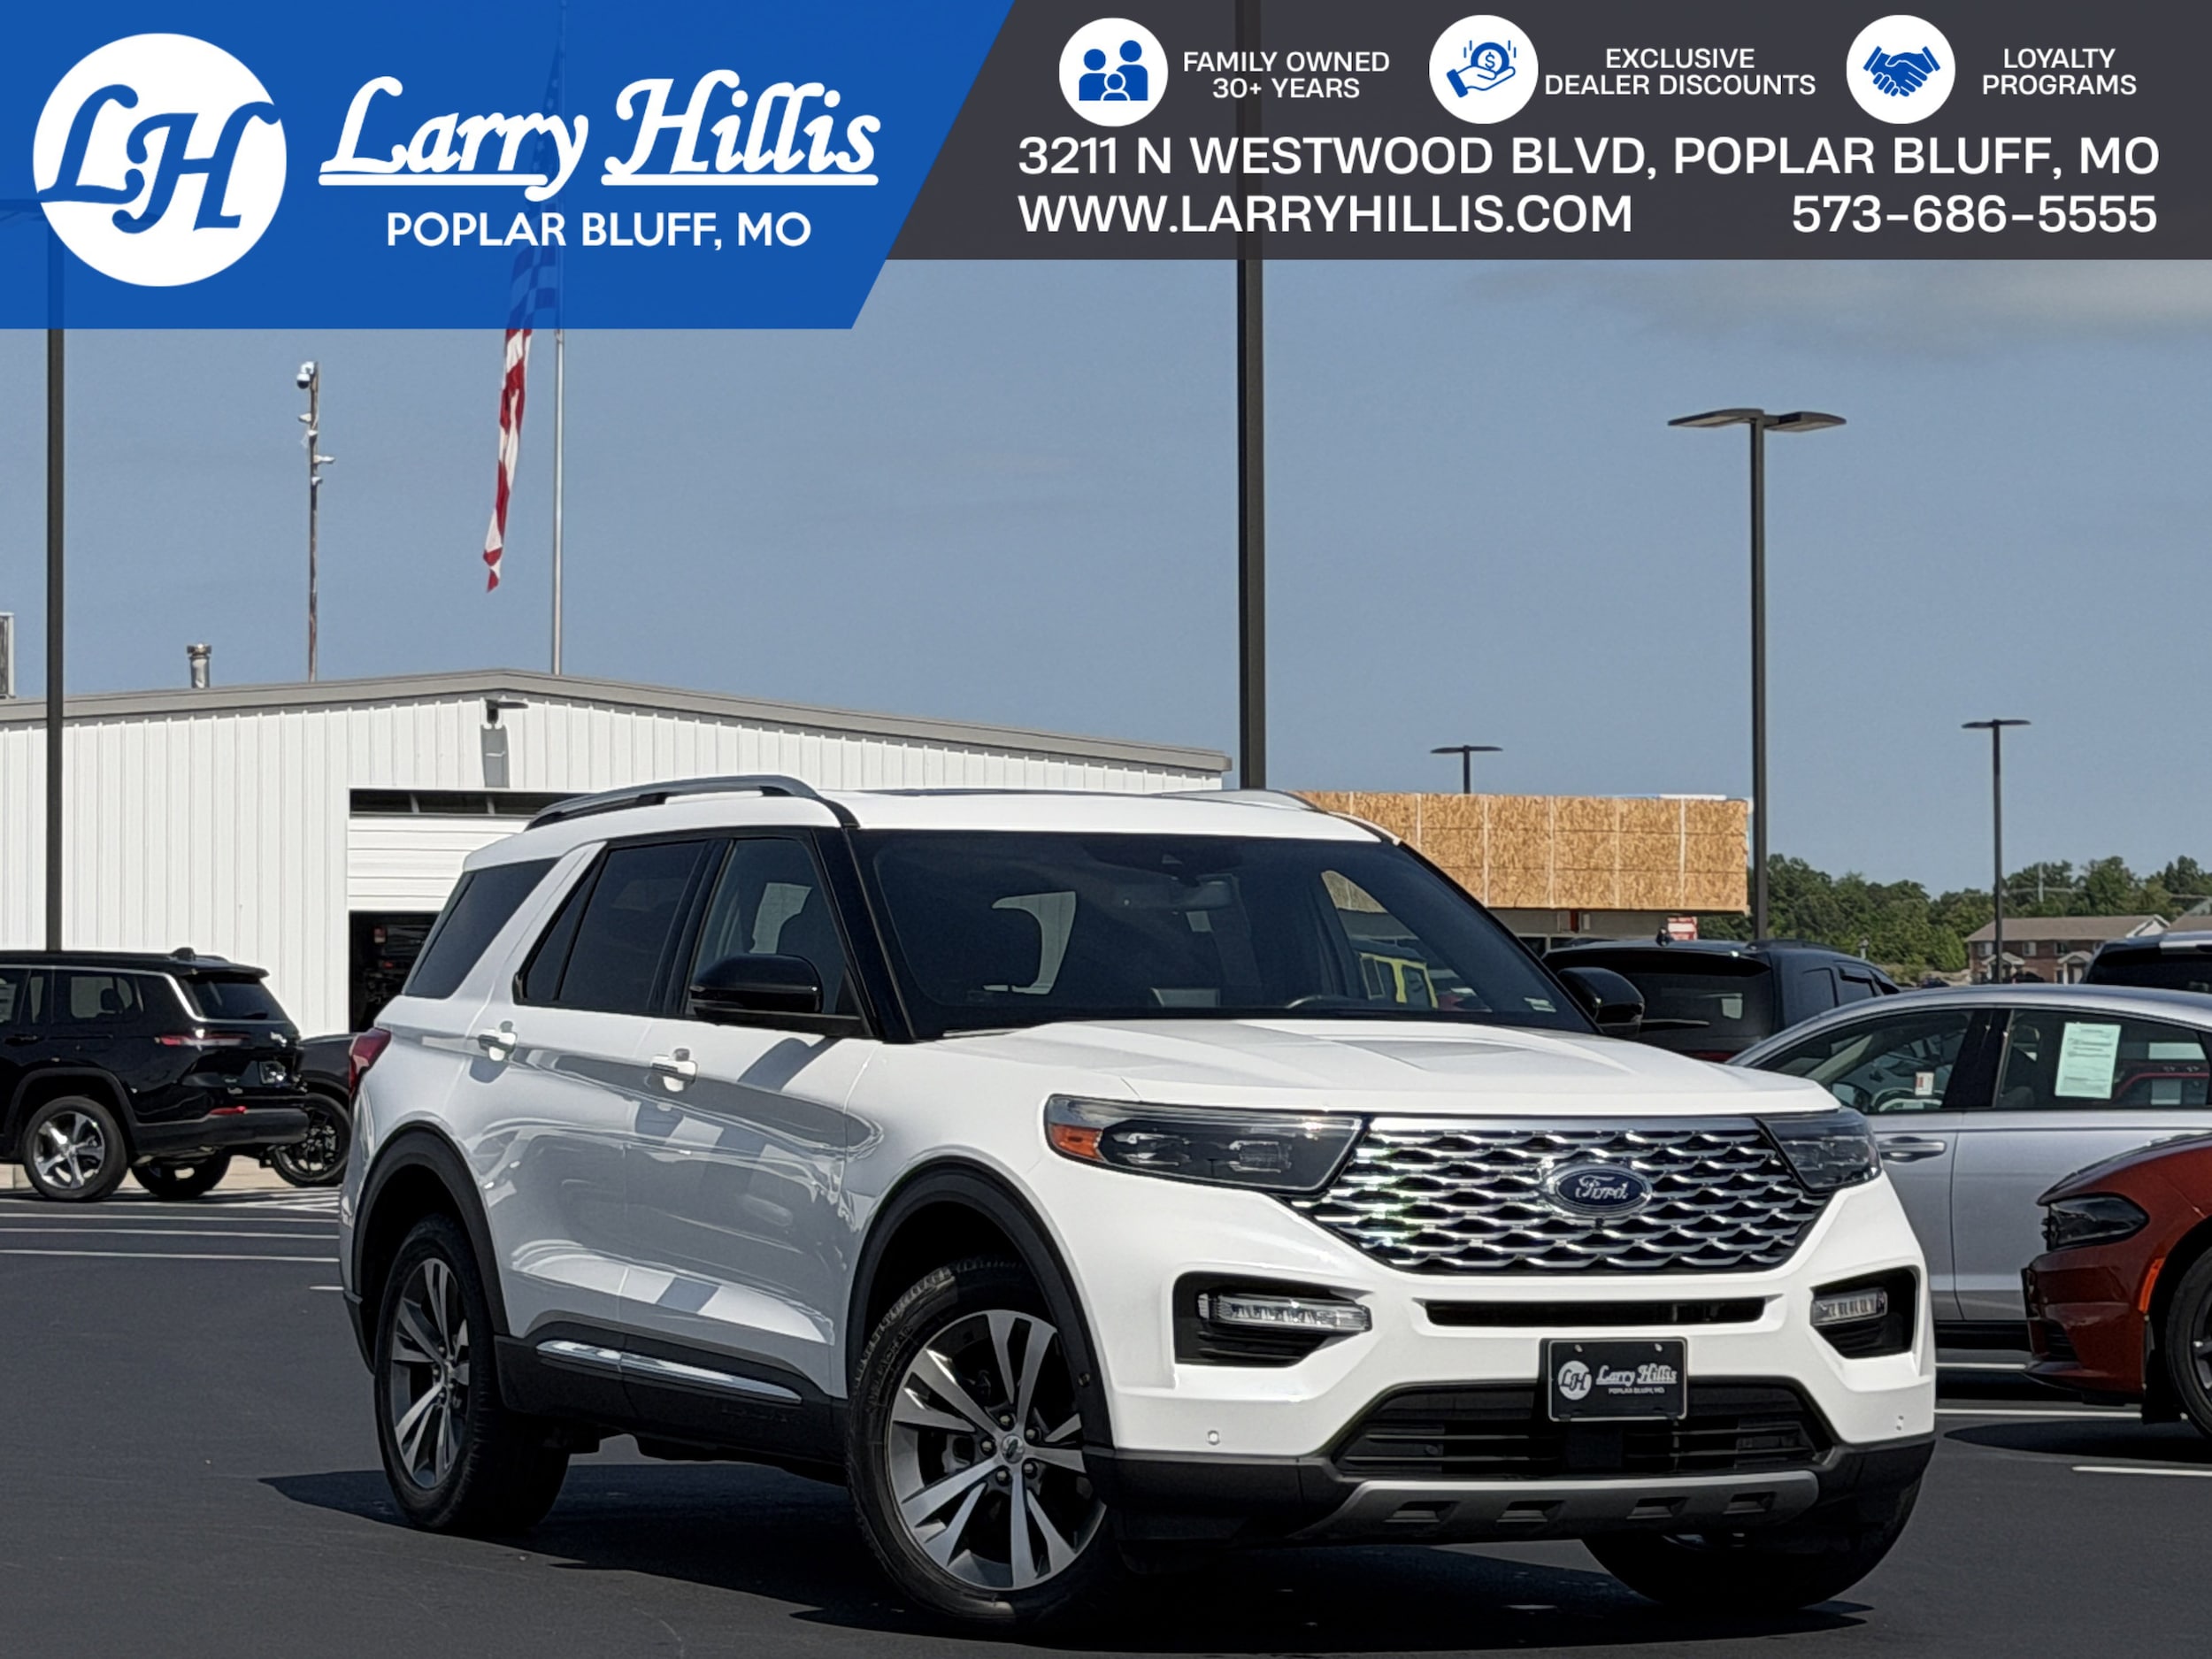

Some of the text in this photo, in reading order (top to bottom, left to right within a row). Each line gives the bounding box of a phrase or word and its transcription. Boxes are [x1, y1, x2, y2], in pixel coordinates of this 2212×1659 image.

[1575, 1174, 1629, 1200] Ford
[1595, 1363, 1678, 1386] Larry Hillis
